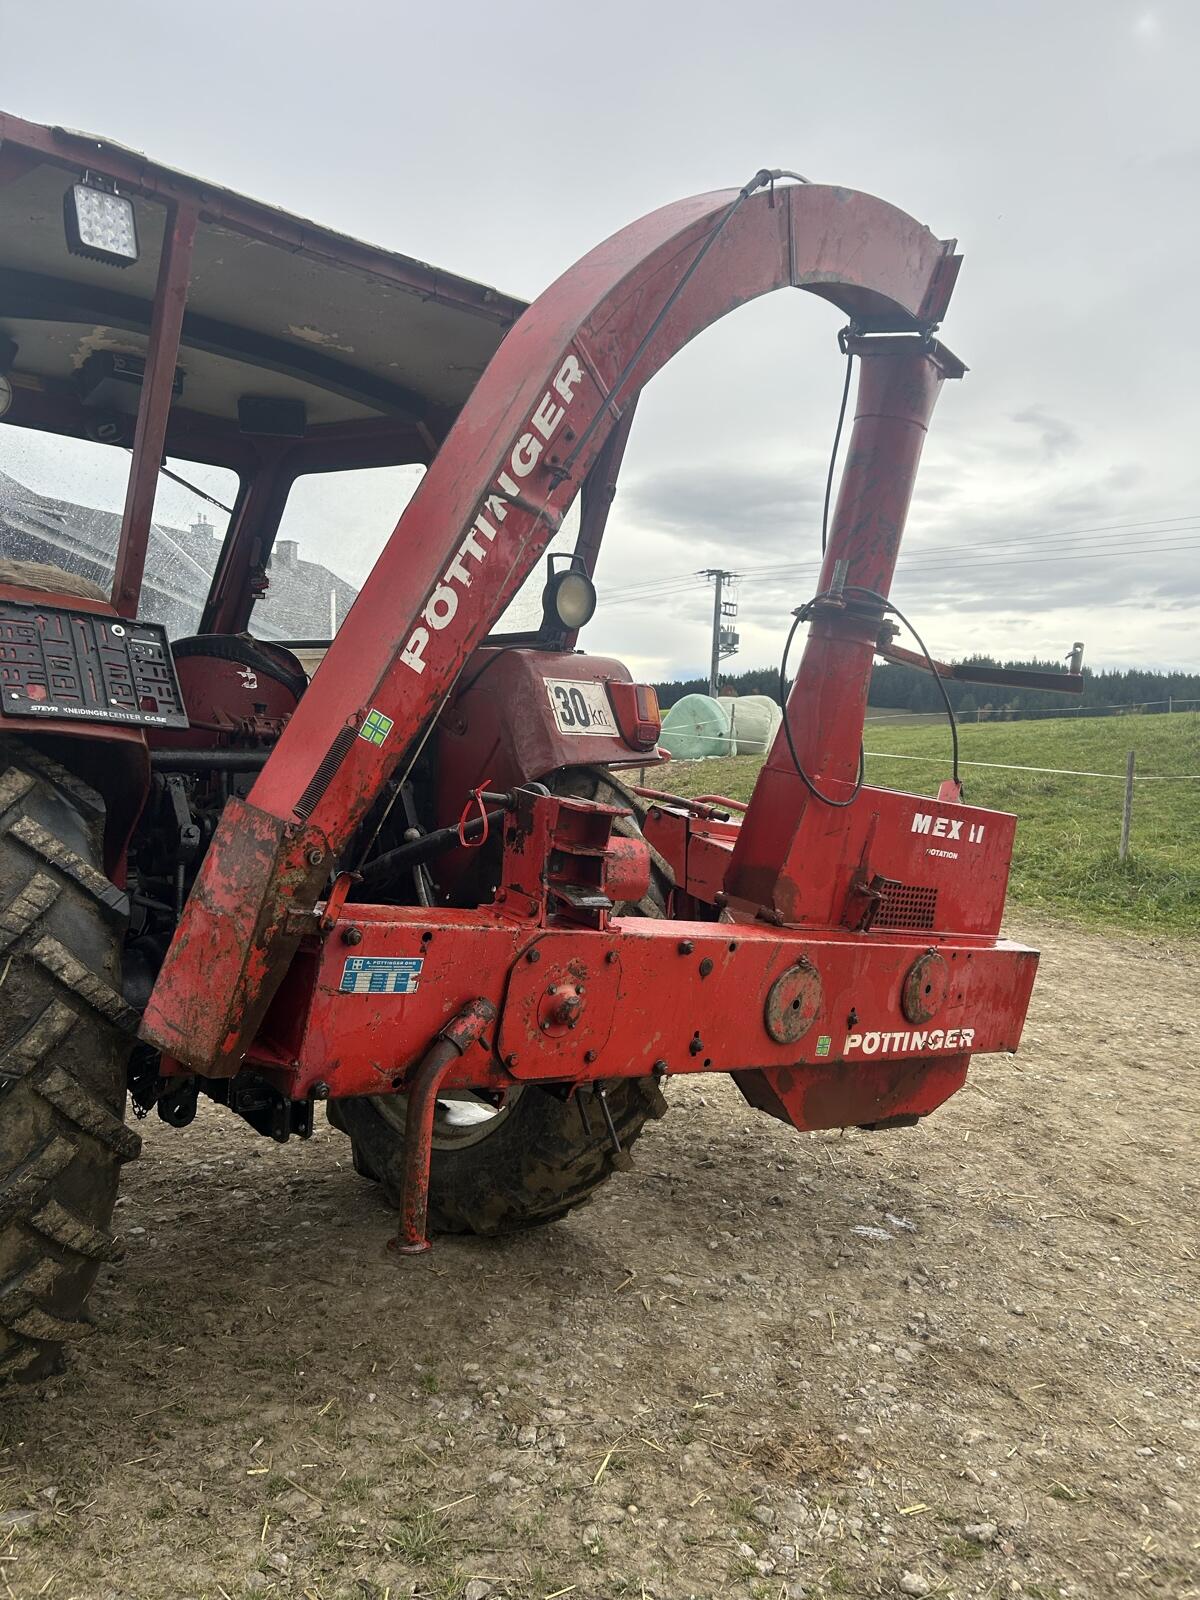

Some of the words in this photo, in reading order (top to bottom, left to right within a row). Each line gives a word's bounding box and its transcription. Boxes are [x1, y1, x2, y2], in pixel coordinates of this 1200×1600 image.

[109, 711, 141, 720] CENTER
[144, 715, 167, 723] CASE
[554, 686, 591, 727] 30
[911, 813, 964, 840] MEX
[968, 823, 985, 844] II
[843, 1028, 975, 1056] PÖTTINGER
